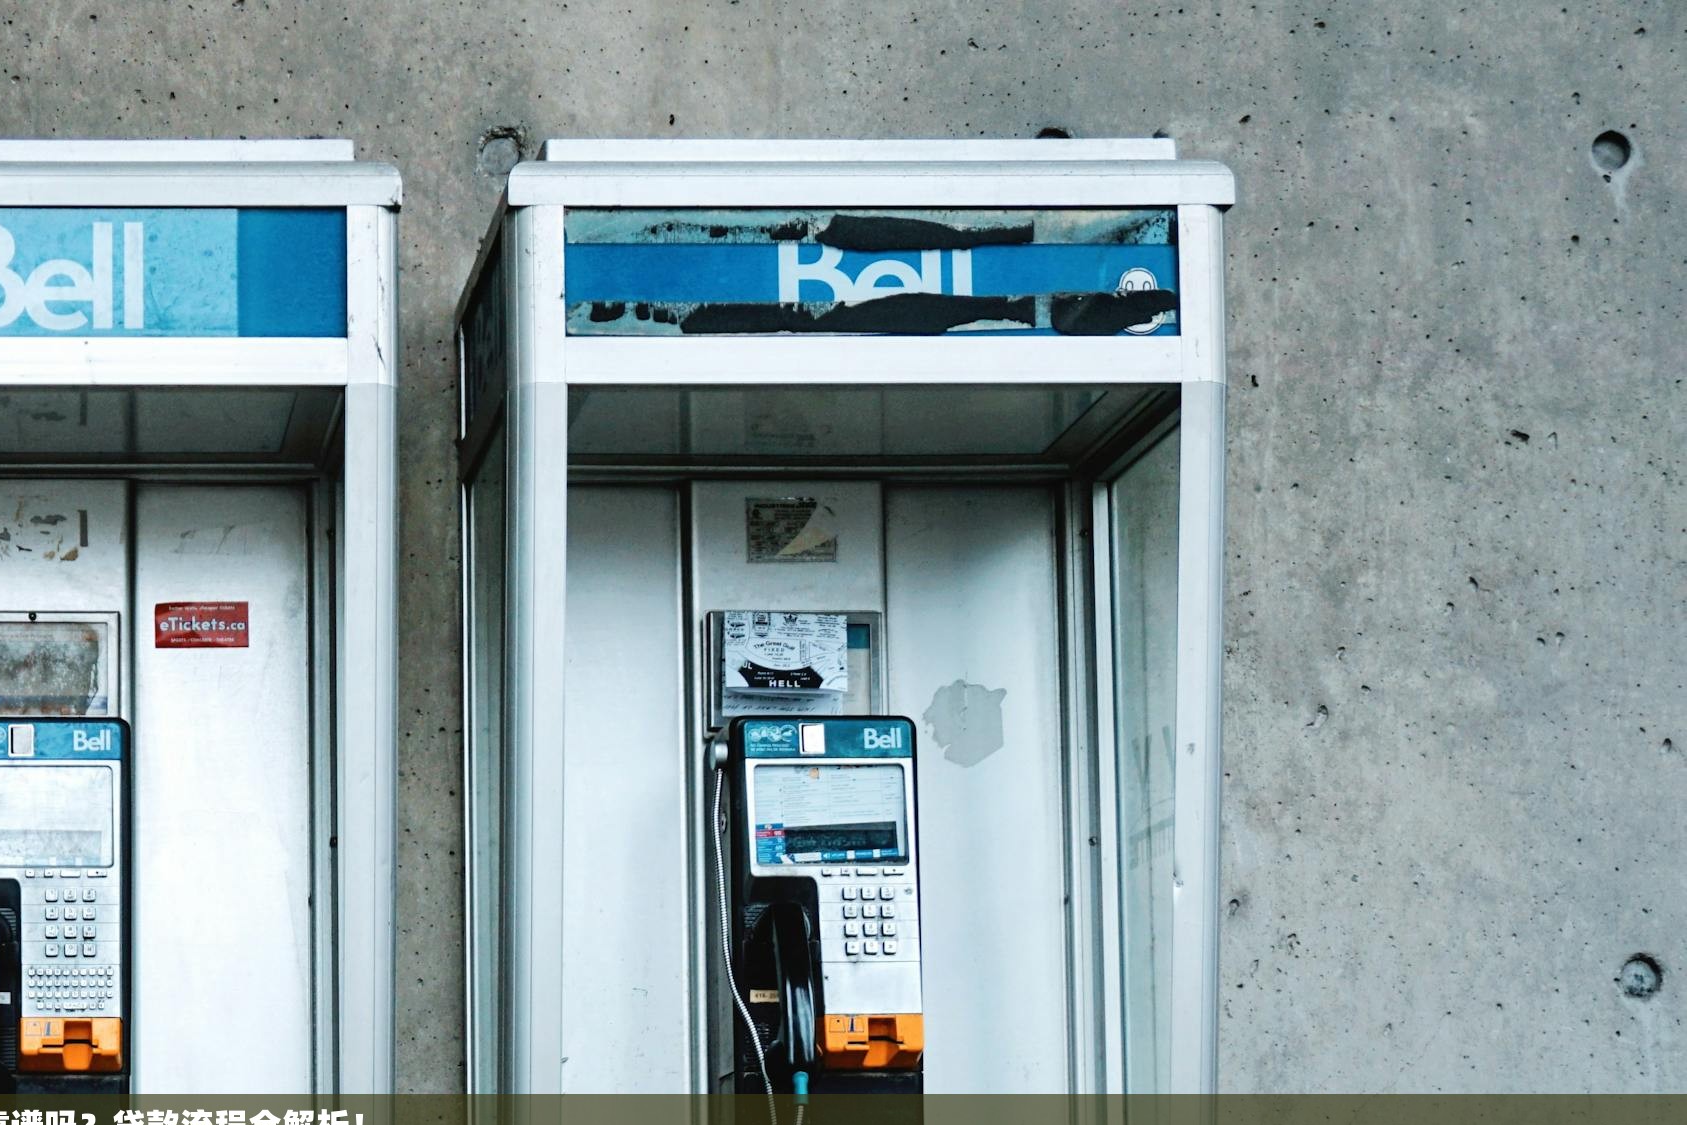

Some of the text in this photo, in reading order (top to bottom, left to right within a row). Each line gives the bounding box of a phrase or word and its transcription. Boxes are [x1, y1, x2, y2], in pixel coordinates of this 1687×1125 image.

[159, 616, 245, 631] eTickets.ca
[768, 679, 801, 688] HELL
[73, 729, 112, 751] Bell
[864, 727, 902, 749] Bell
